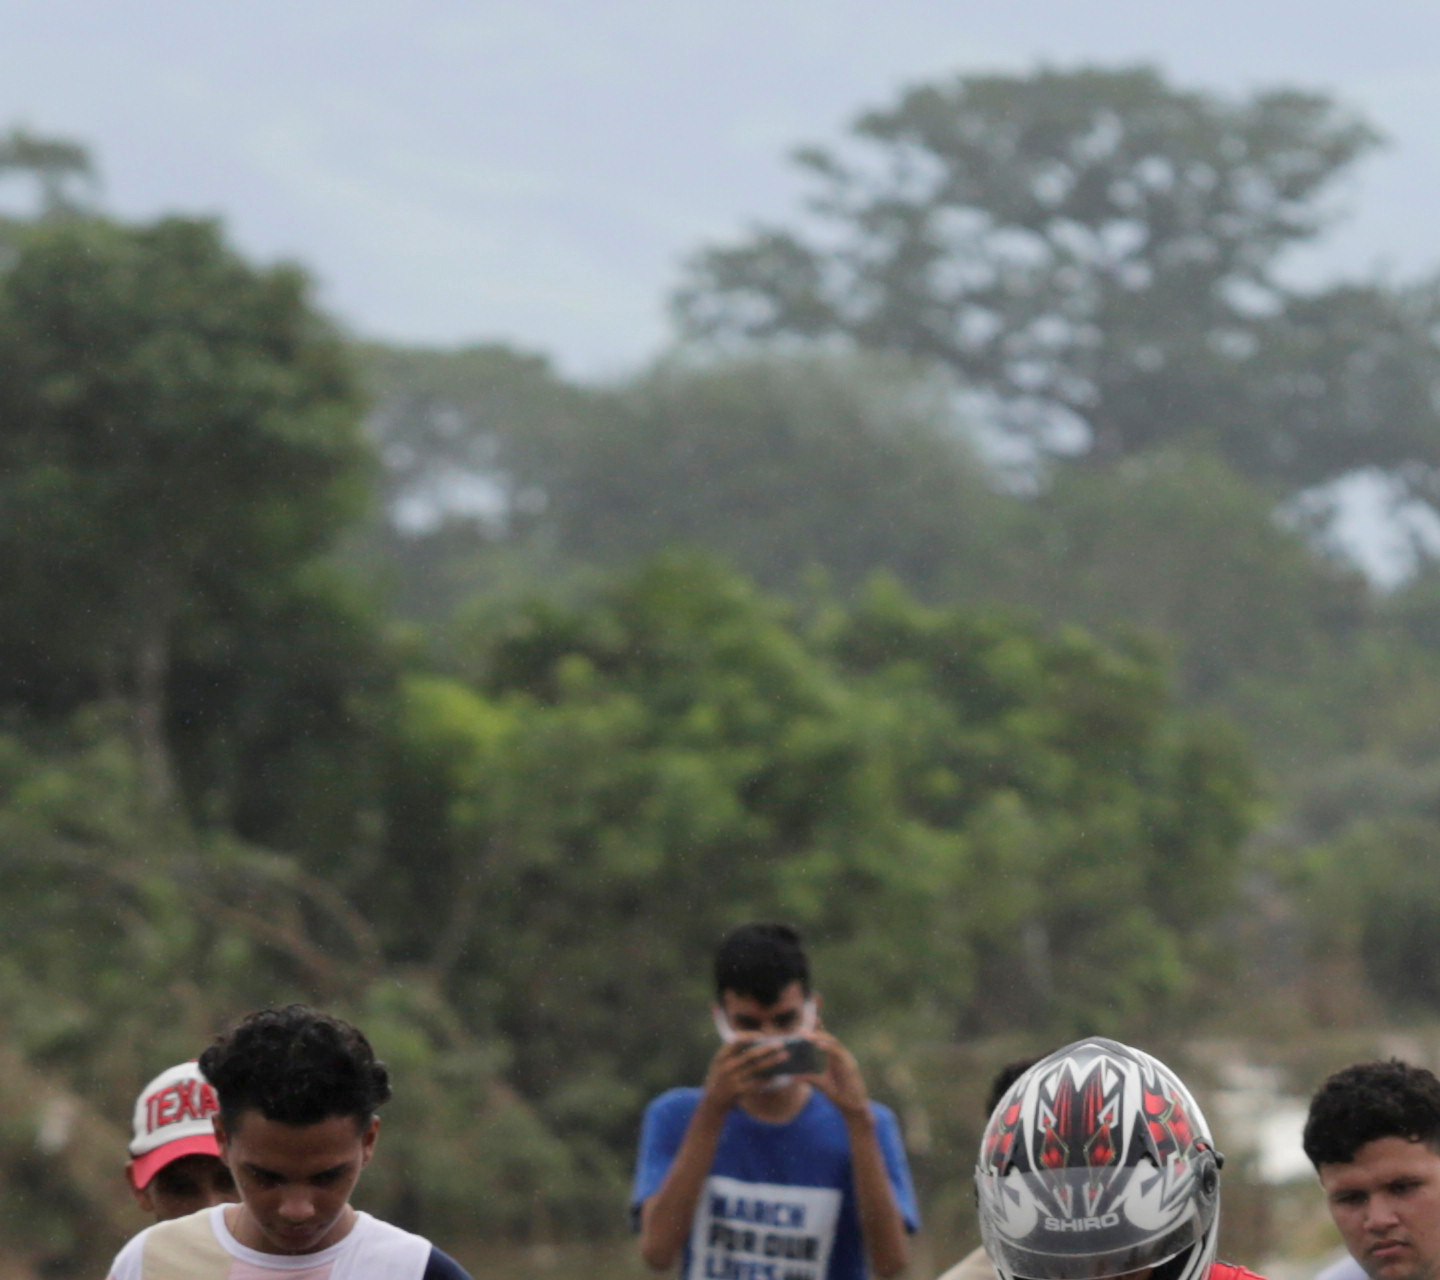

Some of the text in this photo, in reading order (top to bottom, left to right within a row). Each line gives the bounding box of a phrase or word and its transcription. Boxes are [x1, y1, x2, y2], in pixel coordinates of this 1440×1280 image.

[146, 1080, 220, 1134] TEXA
[710, 1194, 806, 1227] MARCH
[1044, 1211, 1120, 1232] SHIRO
[709, 1222, 817, 1261] FOR OUR
